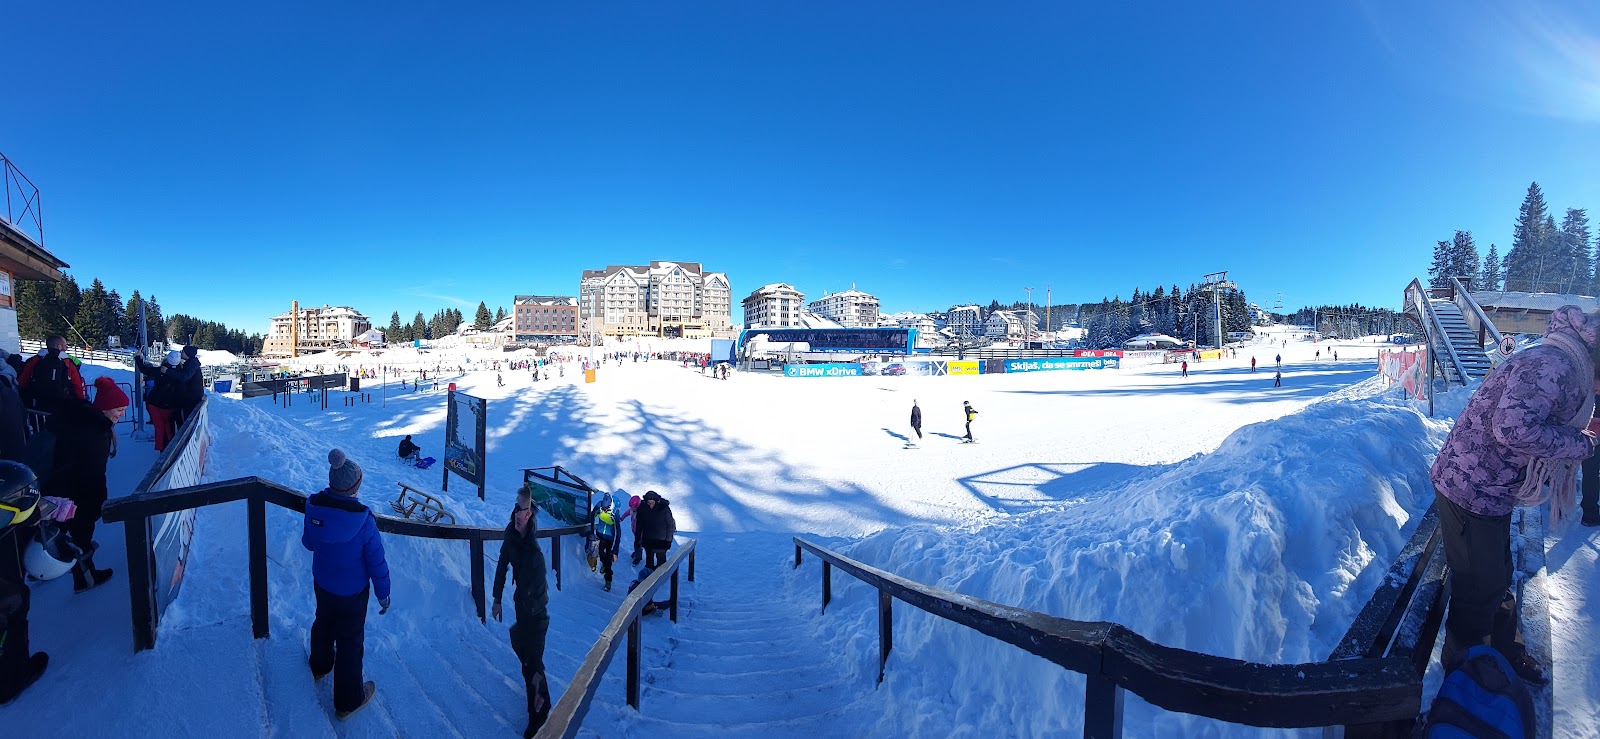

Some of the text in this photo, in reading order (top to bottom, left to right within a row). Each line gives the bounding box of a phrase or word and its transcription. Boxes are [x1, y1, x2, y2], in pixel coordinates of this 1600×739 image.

[928, 360, 947, 376] iX
[1042, 361, 1054, 369] da
[799, 367, 857, 376] BMW xDrive
